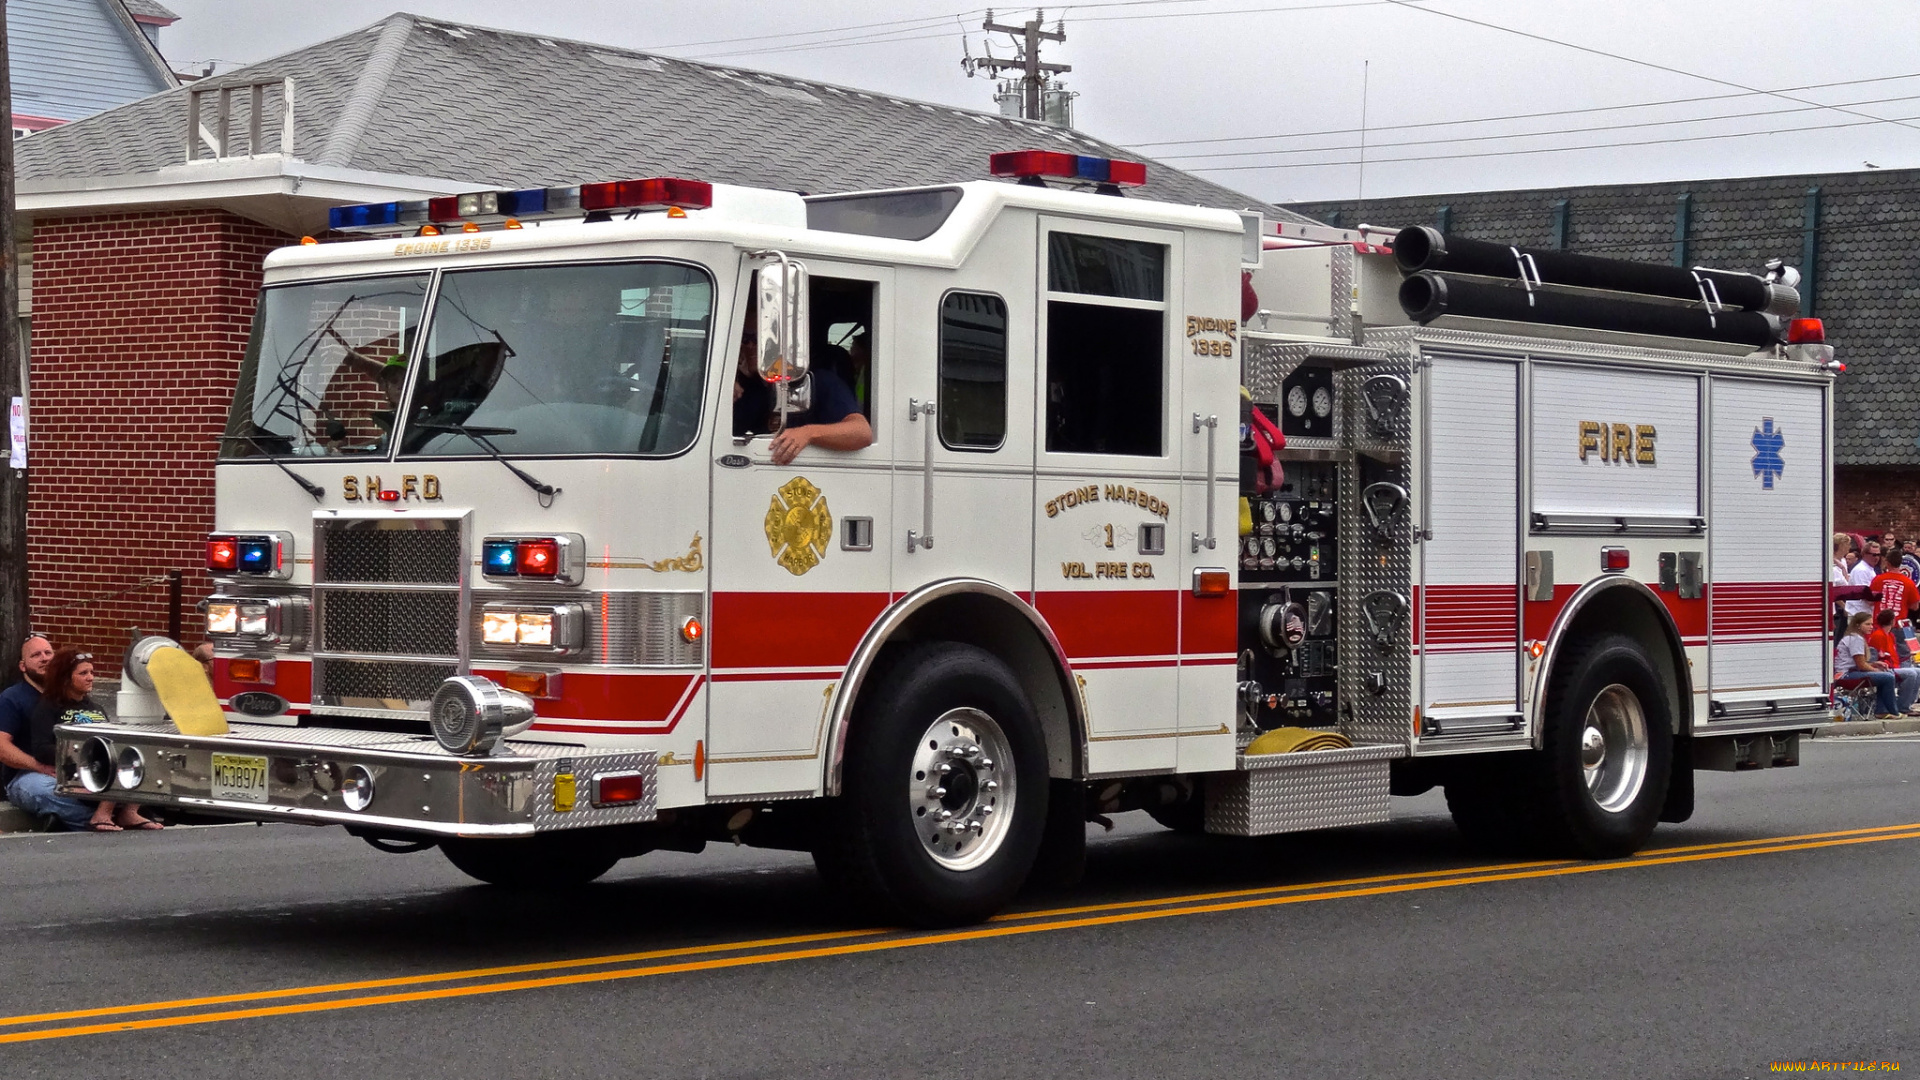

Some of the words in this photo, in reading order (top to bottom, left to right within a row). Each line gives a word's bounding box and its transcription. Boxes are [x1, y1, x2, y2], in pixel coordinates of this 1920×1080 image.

[394, 241, 450, 256] ENGINE
[1186, 315, 1237, 341] ENGINE
[1578, 421, 1658, 465] FIRE
[787, 487, 812, 499] STONE
[1044, 485, 1099, 518] STONE
[1103, 484, 1169, 522] HARBOR
[1104, 523, 1115, 549] 1
[783, 553, 815, 567] HARBOR
[1060, 561, 1094, 579] VOL.
[1096, 561, 1128, 579] FIRE
[1131, 562, 1155, 579] CO.
[241, 694, 277, 711] Pierce
[214, 764, 265, 790] MG38974
